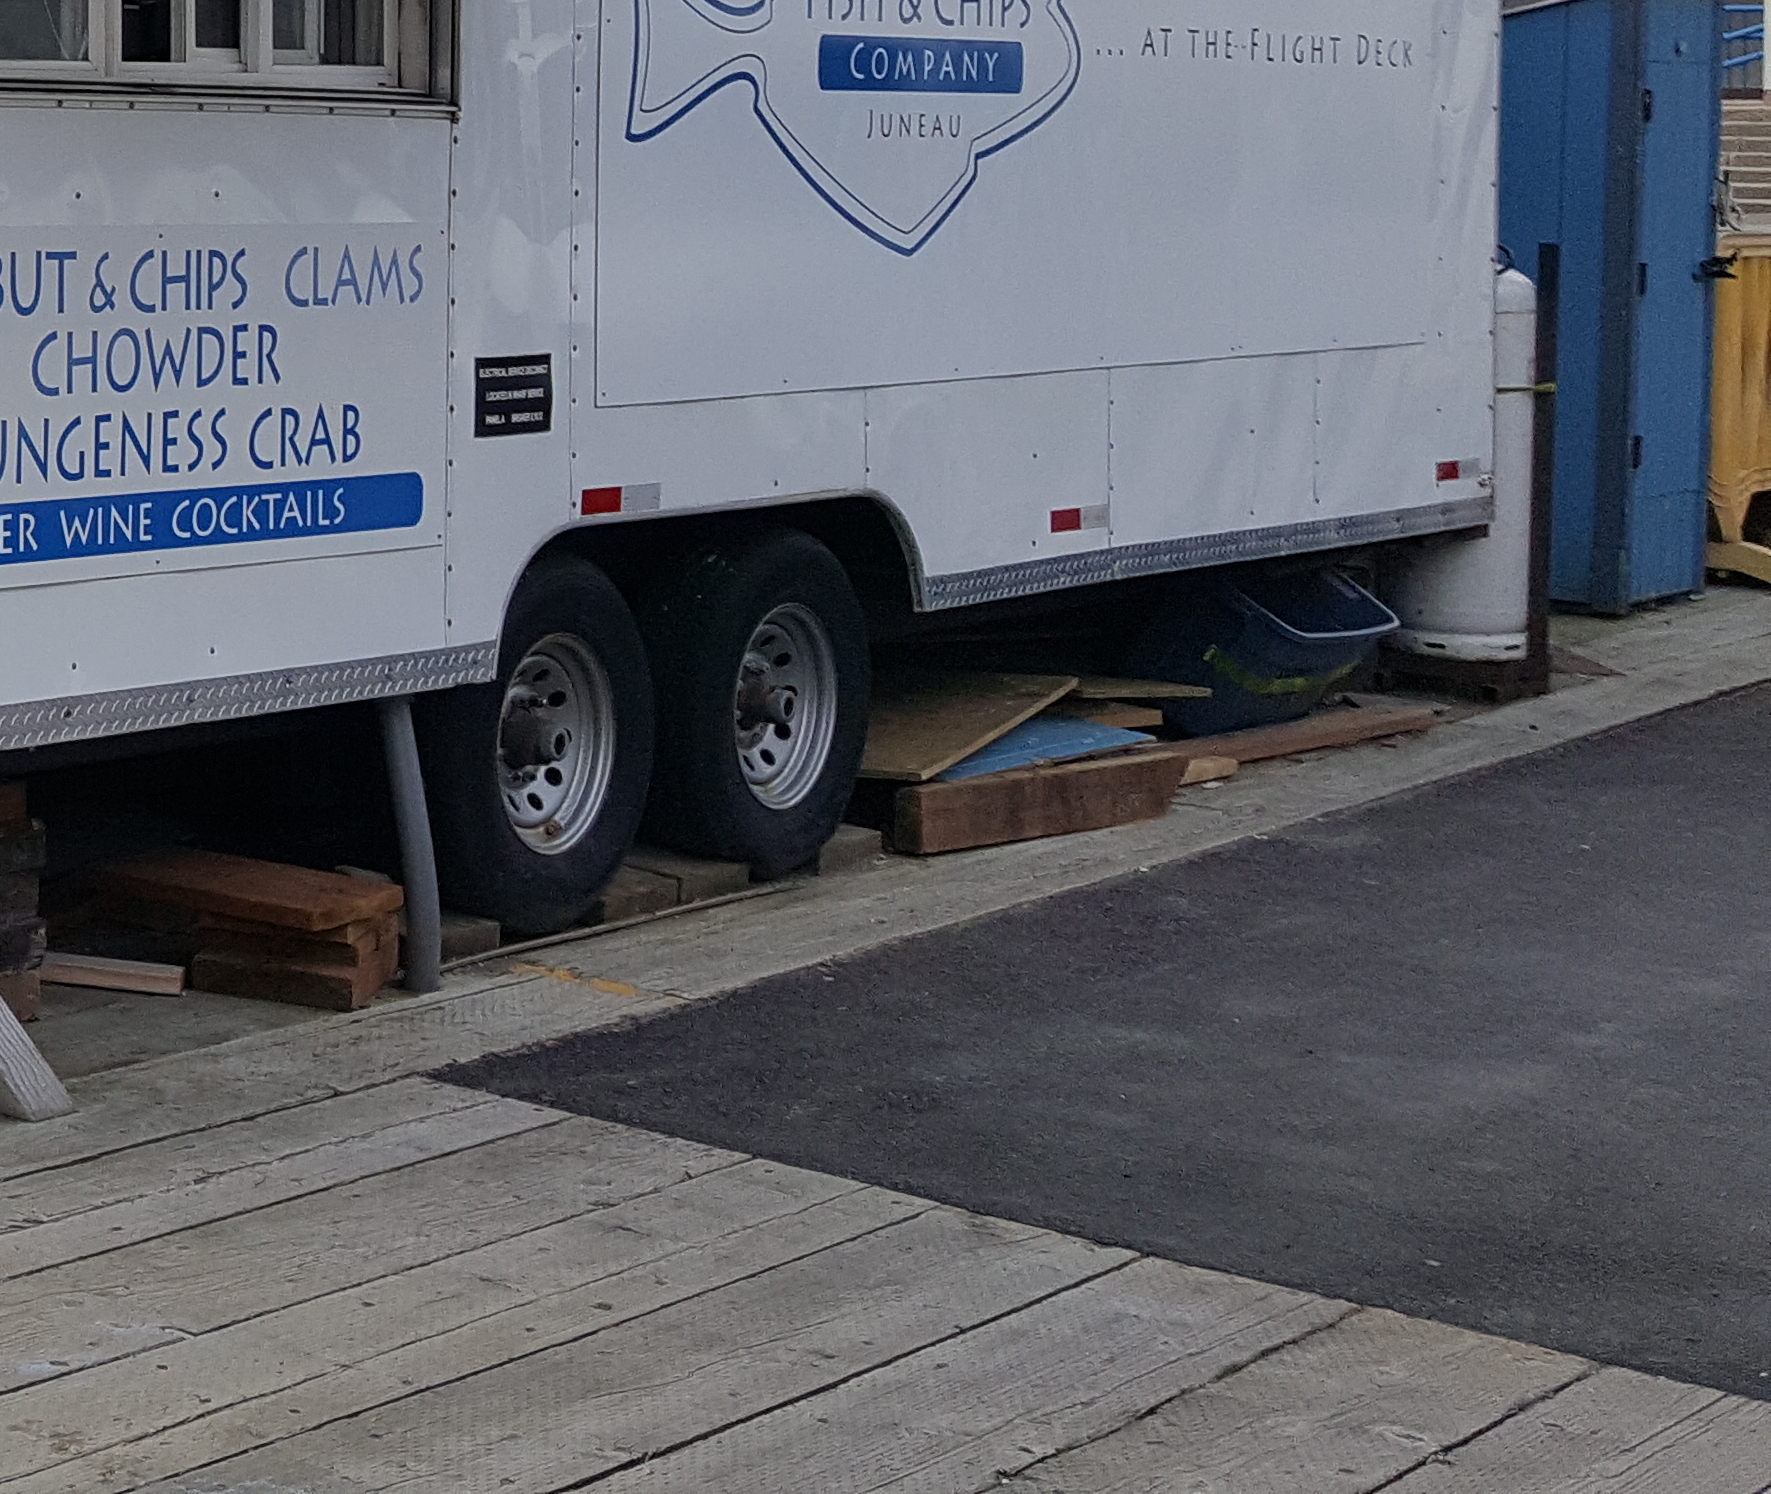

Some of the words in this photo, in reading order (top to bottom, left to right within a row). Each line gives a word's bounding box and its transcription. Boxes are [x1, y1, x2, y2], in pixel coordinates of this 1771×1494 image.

[850, 42, 999, 82] COMPANY
[1141, 27, 1172, 57] AT
[1187, 28, 1233, 59] THE
[1250, 28, 1342, 64] FLIGHT
[1357, 34, 1413, 68] DECK
[867, 109, 962, 139] JUNEAU
[89, 251, 117, 313] &
[129, 247, 249, 313] CHIPS
[284, 243, 425, 307] CLAMS
[31, 322, 282, 397] CHOWDER
[249, 404, 361, 471] CRAB
[60, 501, 154, 549] WINE
[172, 487, 346, 539] COCKTAILS
